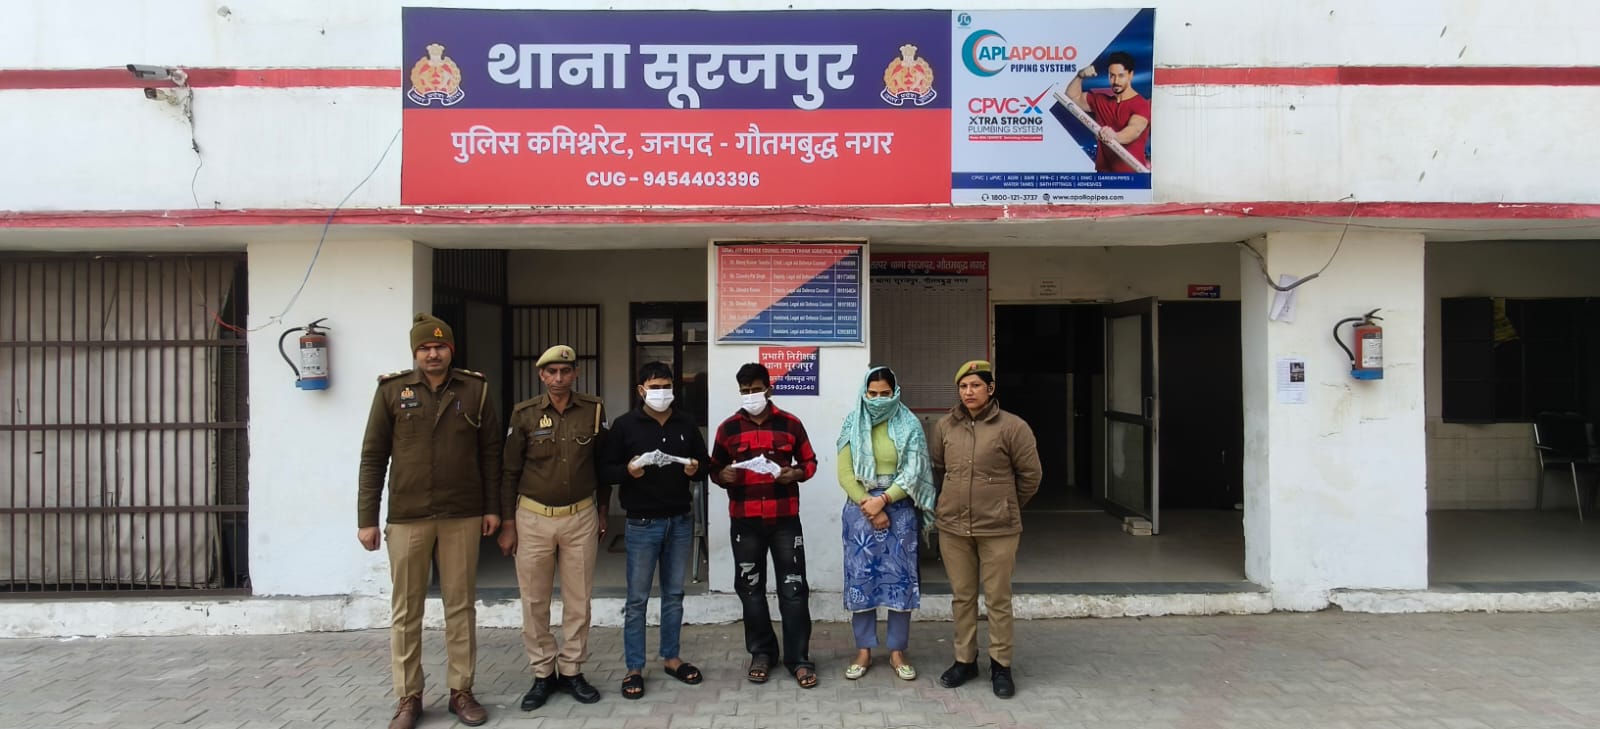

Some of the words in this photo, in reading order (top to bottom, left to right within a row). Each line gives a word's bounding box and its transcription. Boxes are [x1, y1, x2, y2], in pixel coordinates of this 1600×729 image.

[1010, 64, 1038, 73] PIPING
[1040, 64, 1077, 73] SYSTEMS
[487, 43, 631, 89] थाना
[639, 44, 858, 109] सूरजपुर
[969, 116, 998, 125] XTRA
[1001, 116, 1043, 125] STRONG
[968, 126, 1011, 134] PLUMBING
[1012, 126, 1043, 134] SYSTEM
[450, 125, 521, 163] पुलिस
[640, 132, 713, 156] जनपद
[735, 124, 838, 163] गौतमबुद्ध
[845, 132, 894, 155] नगर
[586, 171, 626, 186] CUG
[643, 171, 760, 186] 9454403396
[1052, 194, 1124, 202] www.apollopipes.com
[761, 350, 785, 360] प्रभारी
[786, 350, 817, 361] निरीक्षक
[784, 362, 814, 372] सूरजपुर
